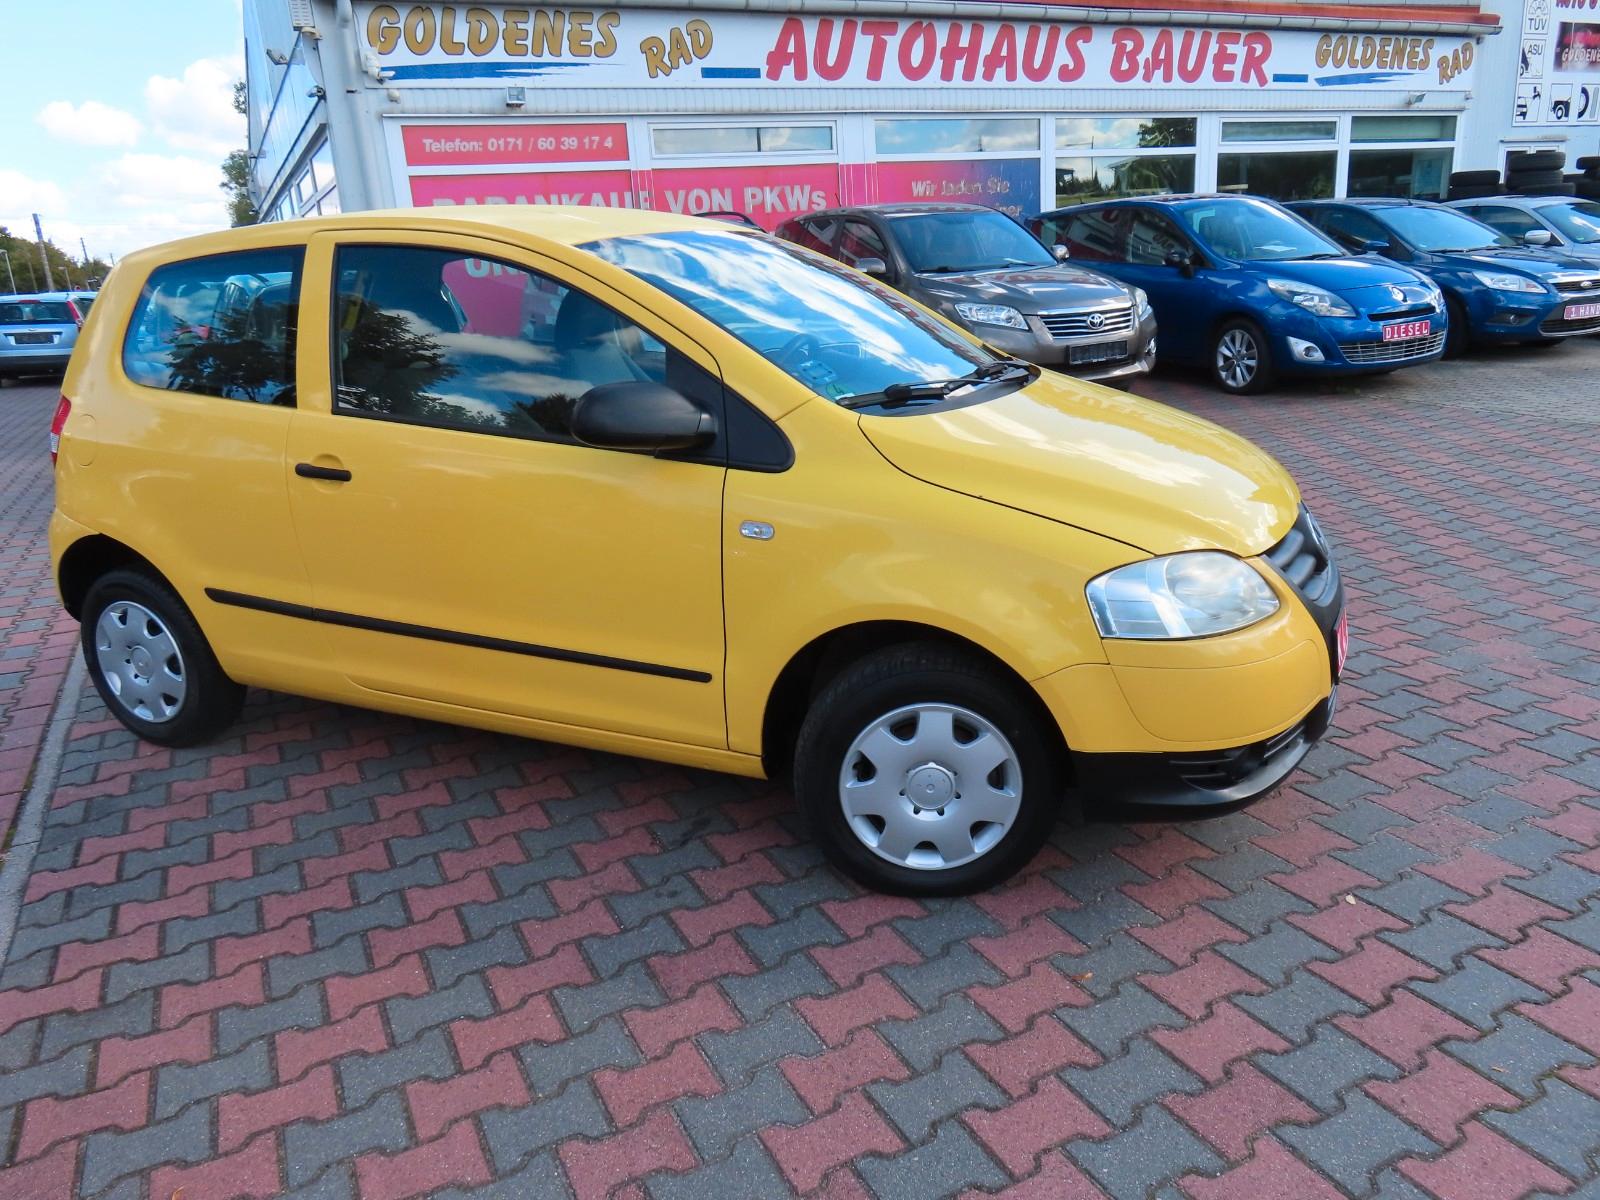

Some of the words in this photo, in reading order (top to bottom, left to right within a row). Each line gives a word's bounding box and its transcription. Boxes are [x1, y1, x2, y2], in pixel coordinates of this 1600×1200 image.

[366, 4, 621, 58] GOLDENES
[640, 18, 714, 79] RAD
[765, 17, 1094, 82] AUTOHAUS
[1109, 27, 1273, 88] BAUER
[1527, 44, 1544, 56] ASU
[1315, 34, 1435, 71] GOLDENES
[1437, 41, 1474, 85] RAD
[422, 138, 483, 153] Telefon:
[487, 137, 523, 152] 0171
[537, 137, 556, 151] 60
[560, 136, 578, 150] 39
[664, 187, 734, 214] VON
[743, 184, 827, 214] PKWs
[911, 180, 937, 197] Wir
[987, 175, 1010, 194] Sie
[1385, 321, 1429, 339] DIESEL
